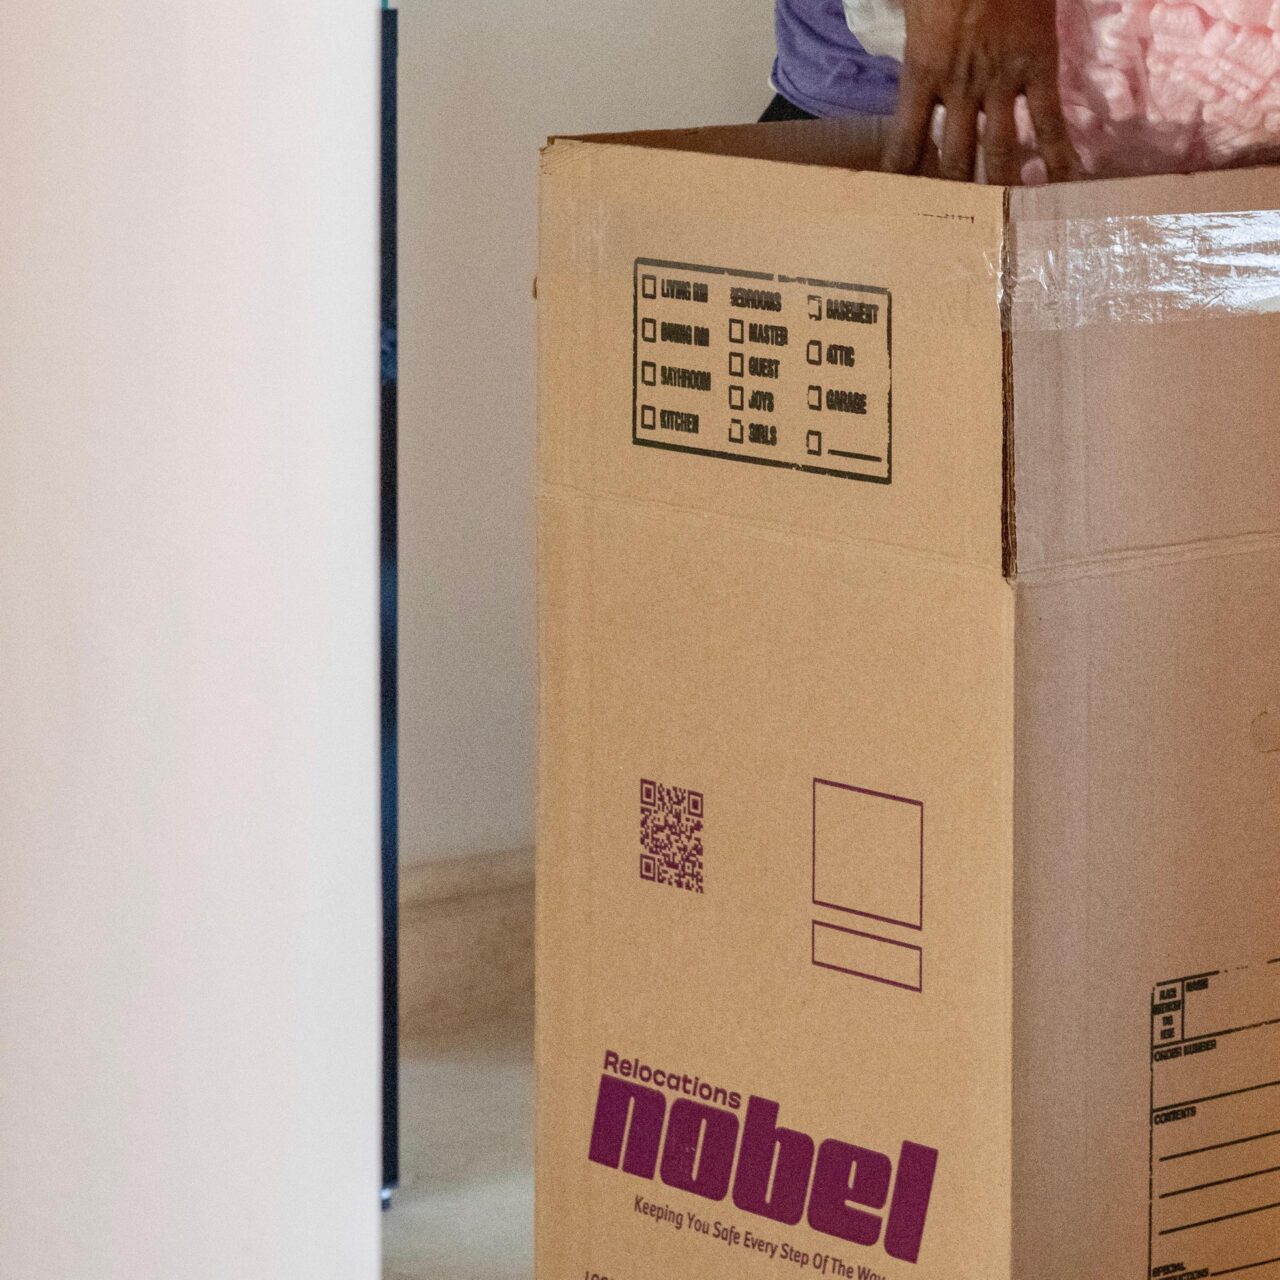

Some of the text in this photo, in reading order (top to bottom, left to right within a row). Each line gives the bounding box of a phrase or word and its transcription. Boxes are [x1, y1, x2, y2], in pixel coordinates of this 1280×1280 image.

[661, 279, 691, 301] LIVING
[749, 323, 788, 346] MASTER
[826, 389, 867, 414] GARAGE
[660, 409, 699, 434] KITCHEN
[603, 1050, 742, 1110] Relocations
[588, 1074, 938, 1264] nobel
[634, 1195, 886, 1280] Keeping You Safe Every Step Of The Wa
